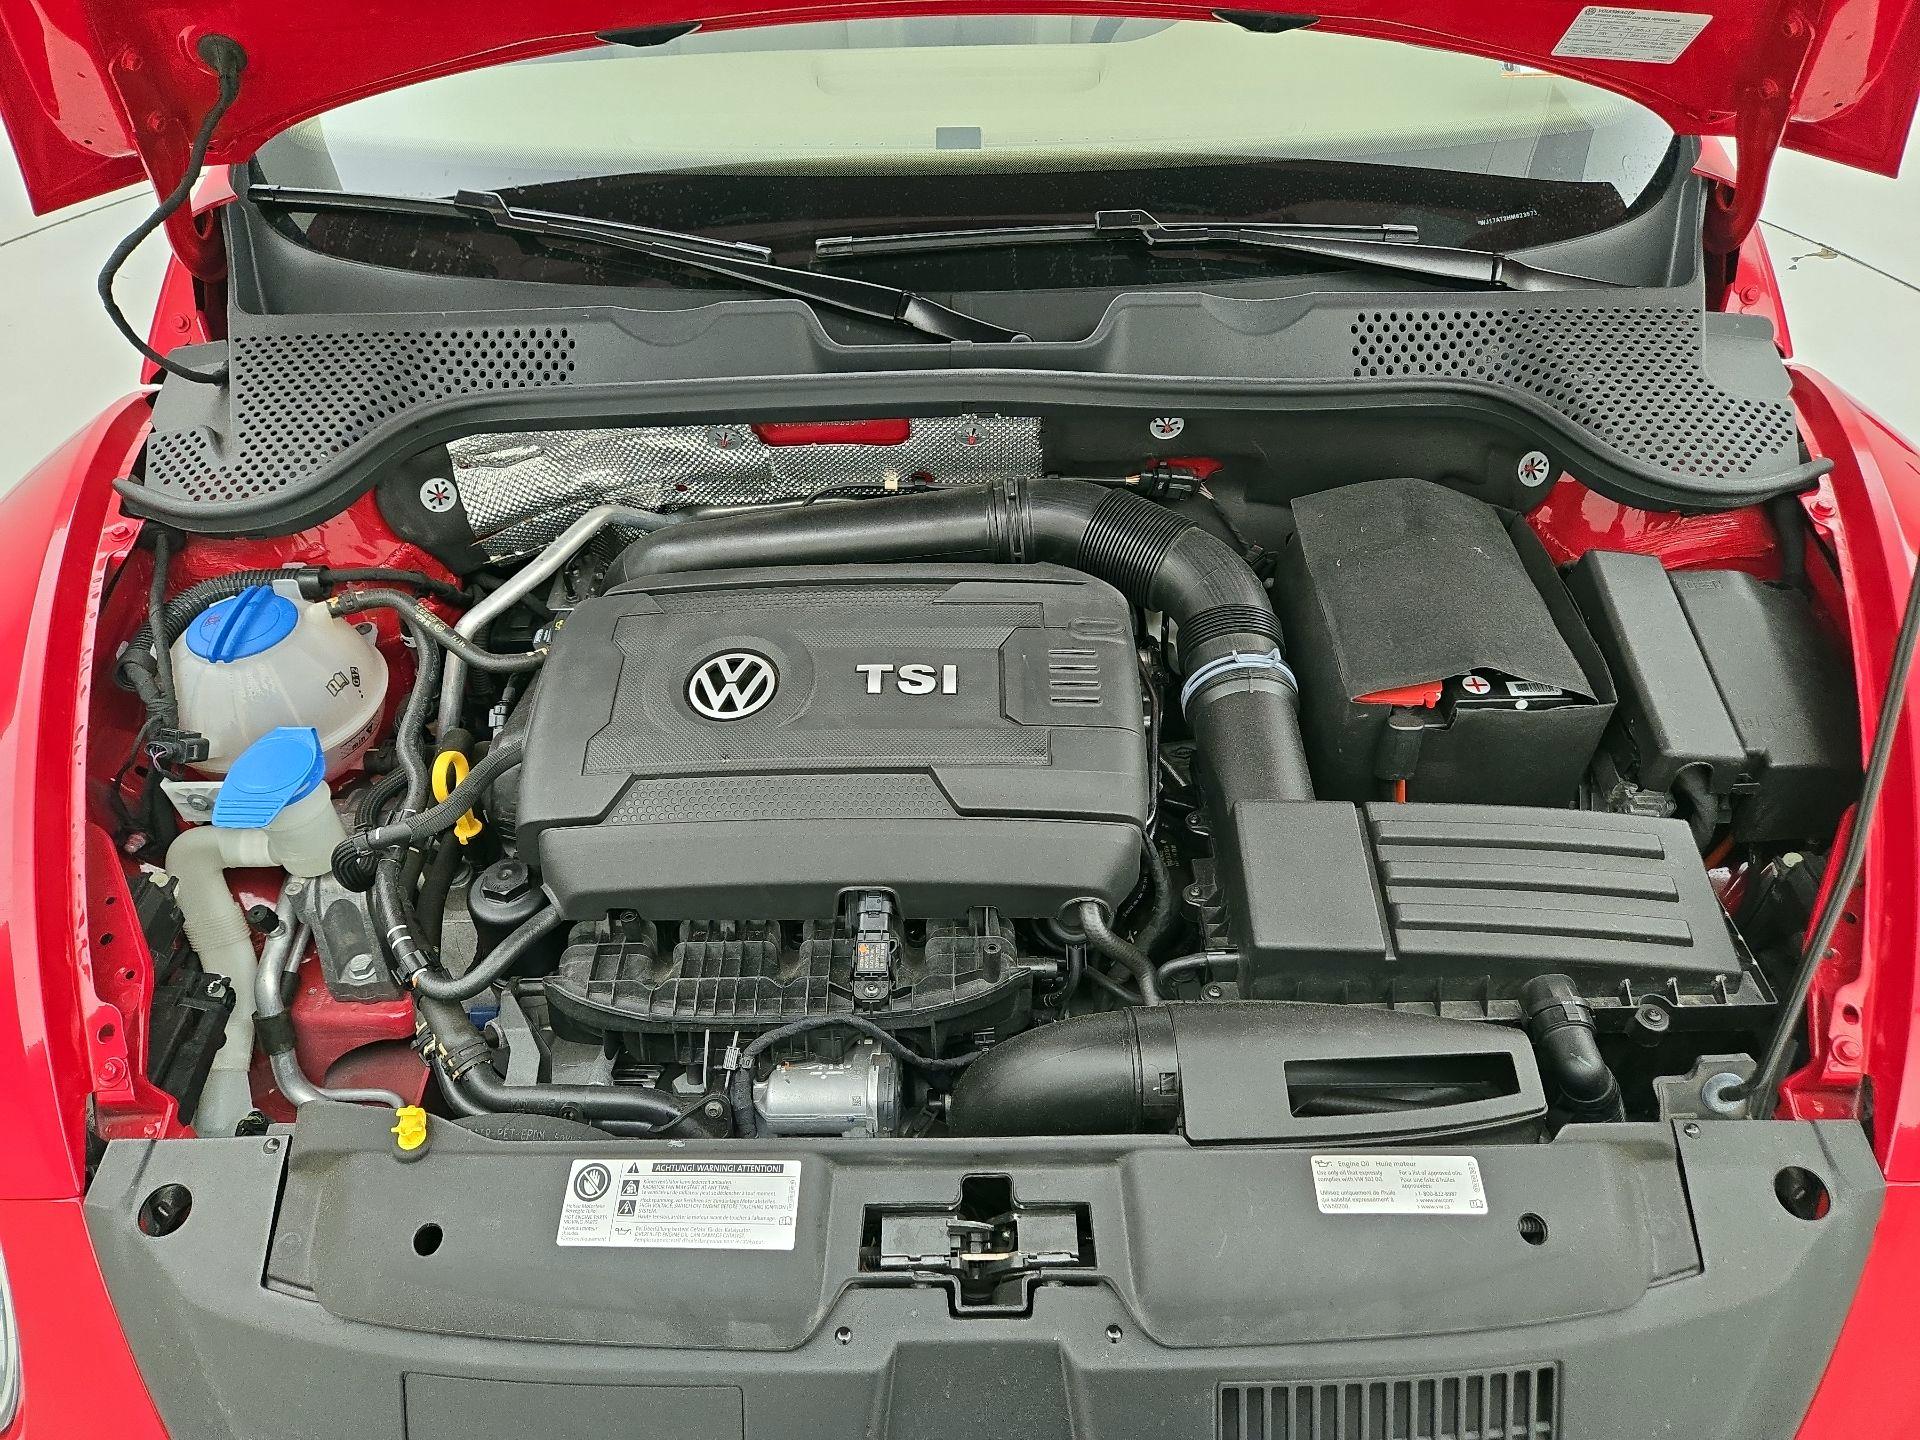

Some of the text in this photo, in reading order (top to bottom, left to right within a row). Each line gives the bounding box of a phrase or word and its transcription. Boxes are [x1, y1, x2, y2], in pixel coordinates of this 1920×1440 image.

[856, 664, 957, 694] TSI
[352, 736, 366, 750] min
[655, 1164, 781, 1173] ACHTUNG! WARNING! ATTENTION!
